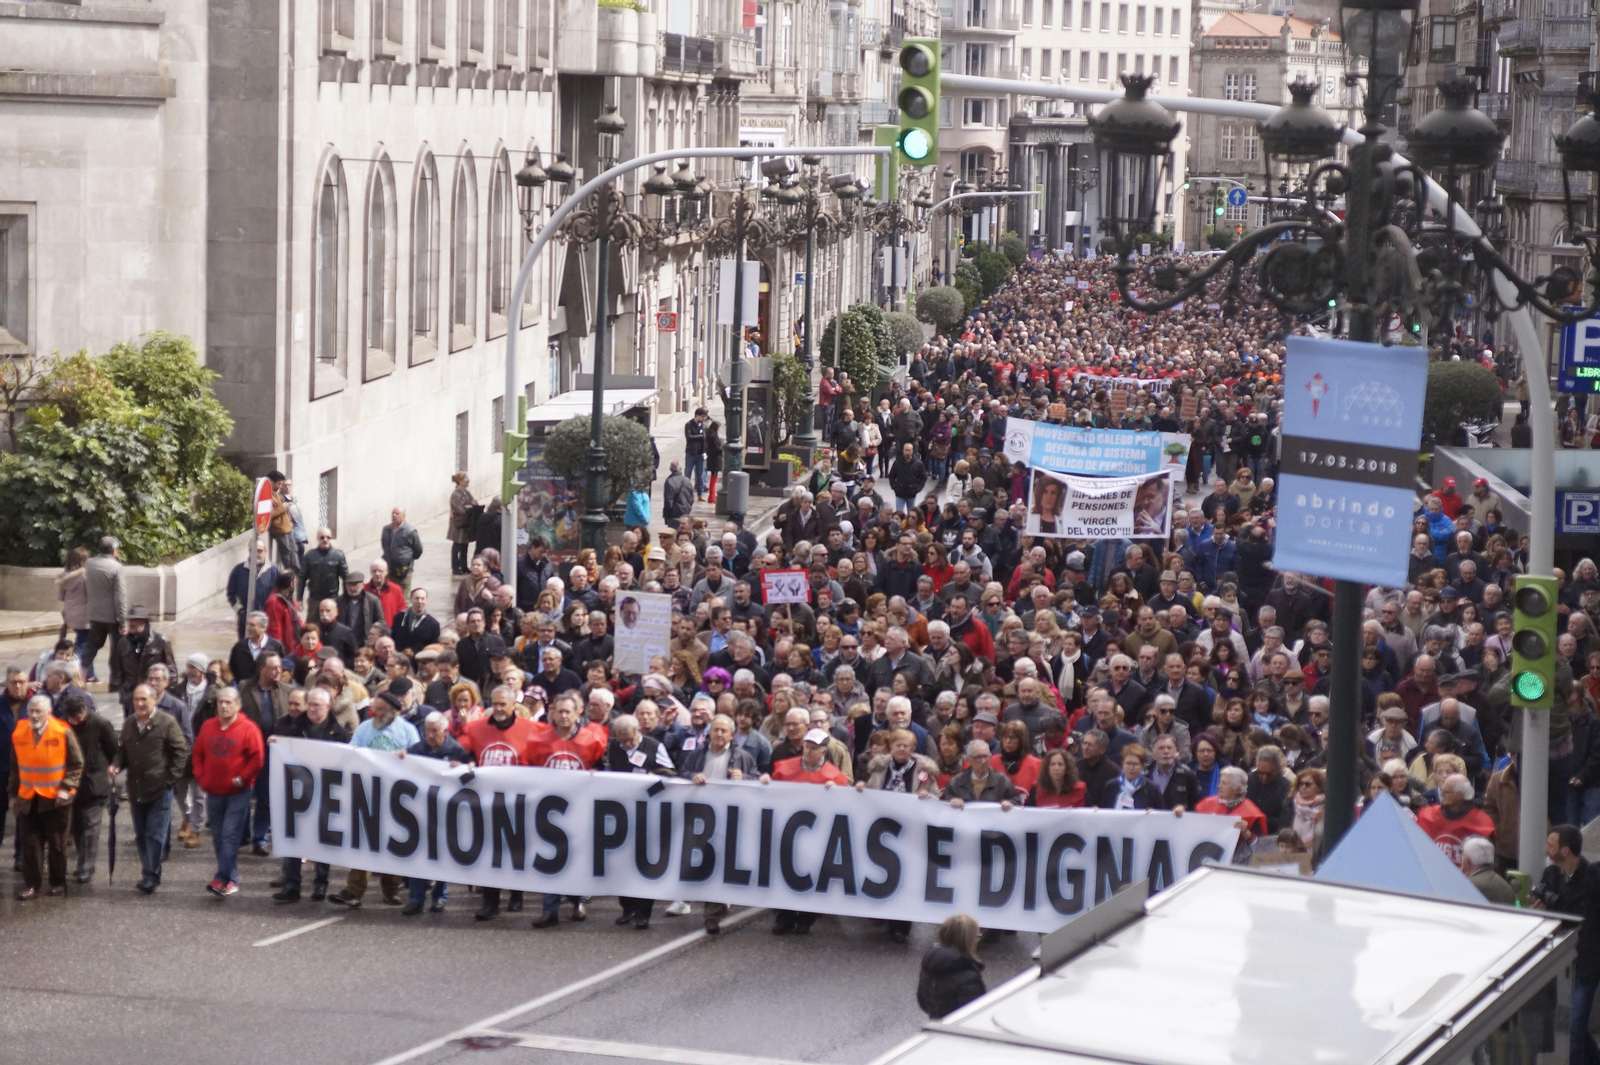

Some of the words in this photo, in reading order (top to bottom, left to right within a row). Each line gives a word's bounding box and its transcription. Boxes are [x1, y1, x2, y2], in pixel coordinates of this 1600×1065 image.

[1037, 129, 1063, 142] ABANCA
[1573, 318, 1600, 362] P
[1362, 415, 1404, 428] SEDE
[1036, 427, 1096, 444] MOVEMENTO
[1097, 433, 1133, 446] GALEGO
[1134, 434, 1160, 448] POLA
[1045, 442, 1087, 458] DEFENSA
[1089, 447, 1102, 458] DO
[1104, 448, 1147, 461] SISTEMA
[1042, 454, 1083, 469] PÚBLICO
[1085, 460, 1097, 471] DE
[1099, 460, 1147, 474] PENSIÓNS
[1300, 452, 1397, 475] 17.03.2018
[1068, 478, 1096, 488] BANCA
[1097, 479, 1136, 488] PRIVADA
[1120, 491, 1133, 499] DE
[1071, 502, 1129, 511] PENSIONES:
[1298, 494, 1394, 518] abrindo
[1571, 501, 1593, 524] P
[1067, 527, 1084, 536] DEL
[1305, 515, 1384, 536] portas
[484, 749, 514, 766] UGT
[284, 764, 570, 875] PENSIÓNS
[592, 781, 903, 900] PÚBLICAS
[925, 825, 955, 903] E
